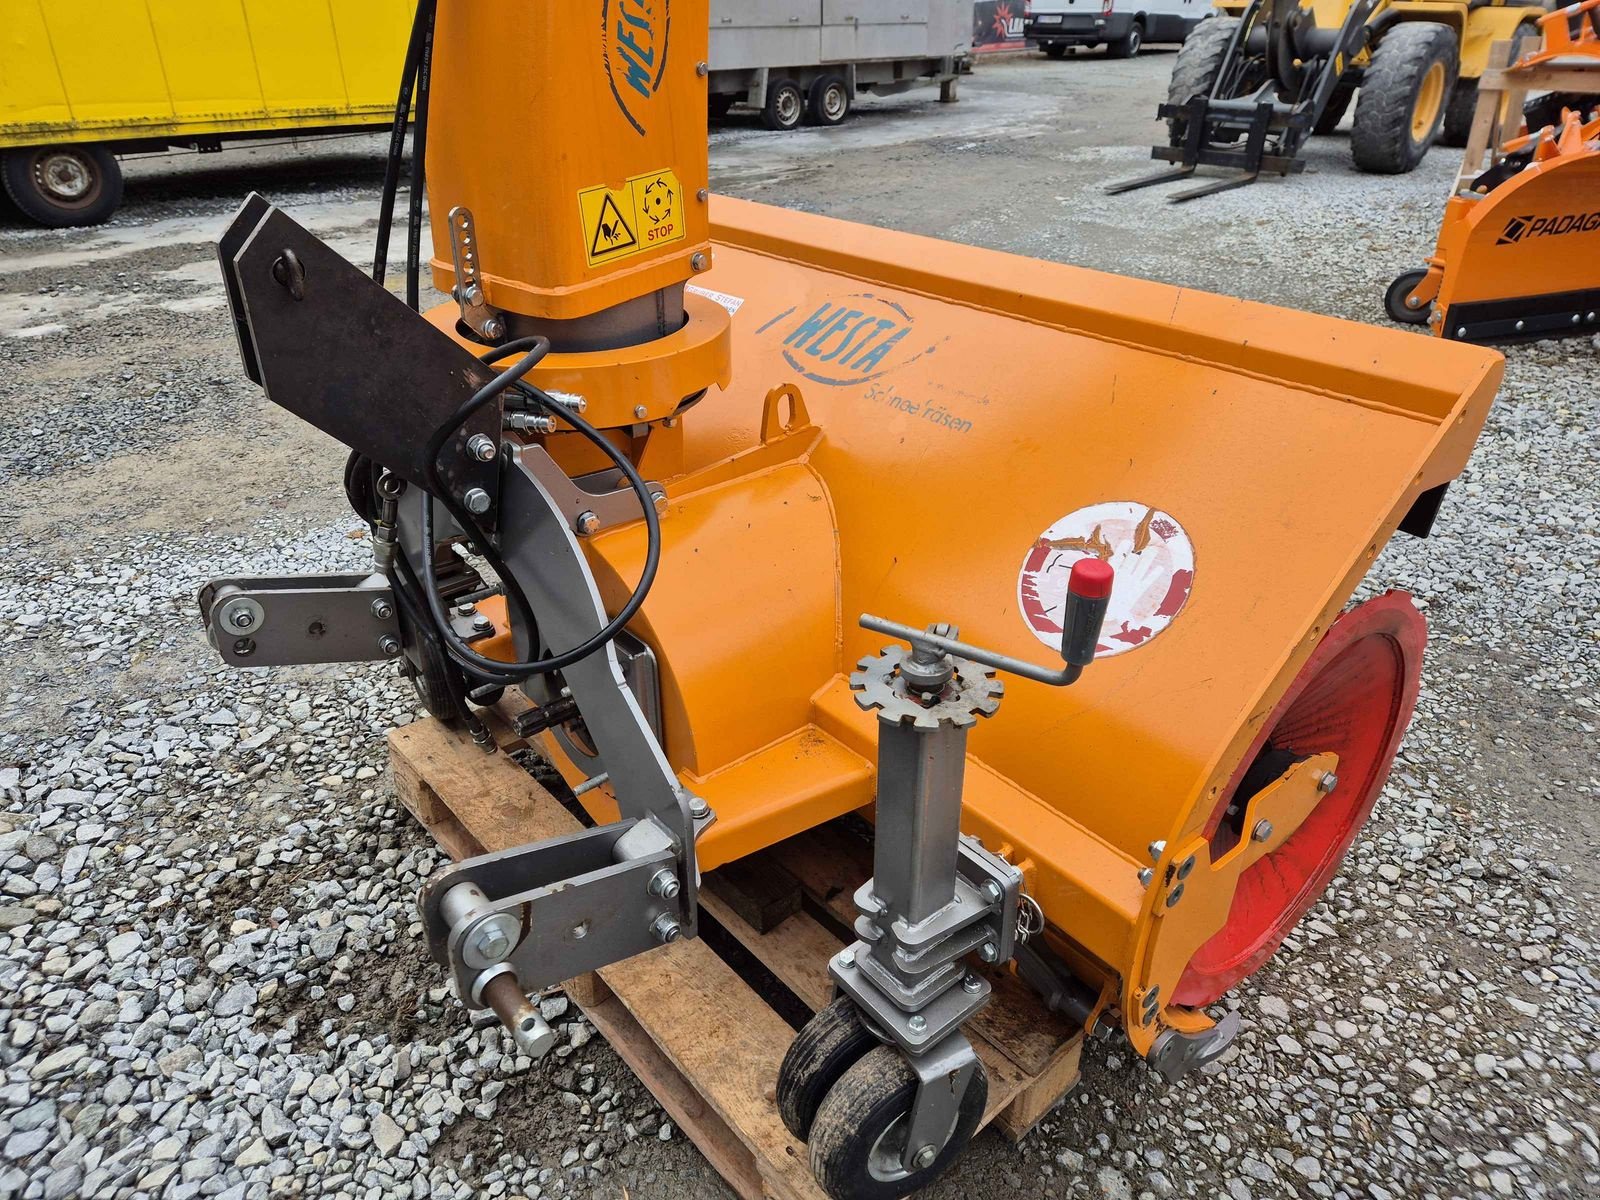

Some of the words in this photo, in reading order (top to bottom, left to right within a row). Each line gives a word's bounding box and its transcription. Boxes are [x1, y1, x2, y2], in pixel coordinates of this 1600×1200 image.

[647, 223, 674, 242] STOP
[715, 294, 742, 307] STEFAN
[782, 301, 912, 374] WESTA
